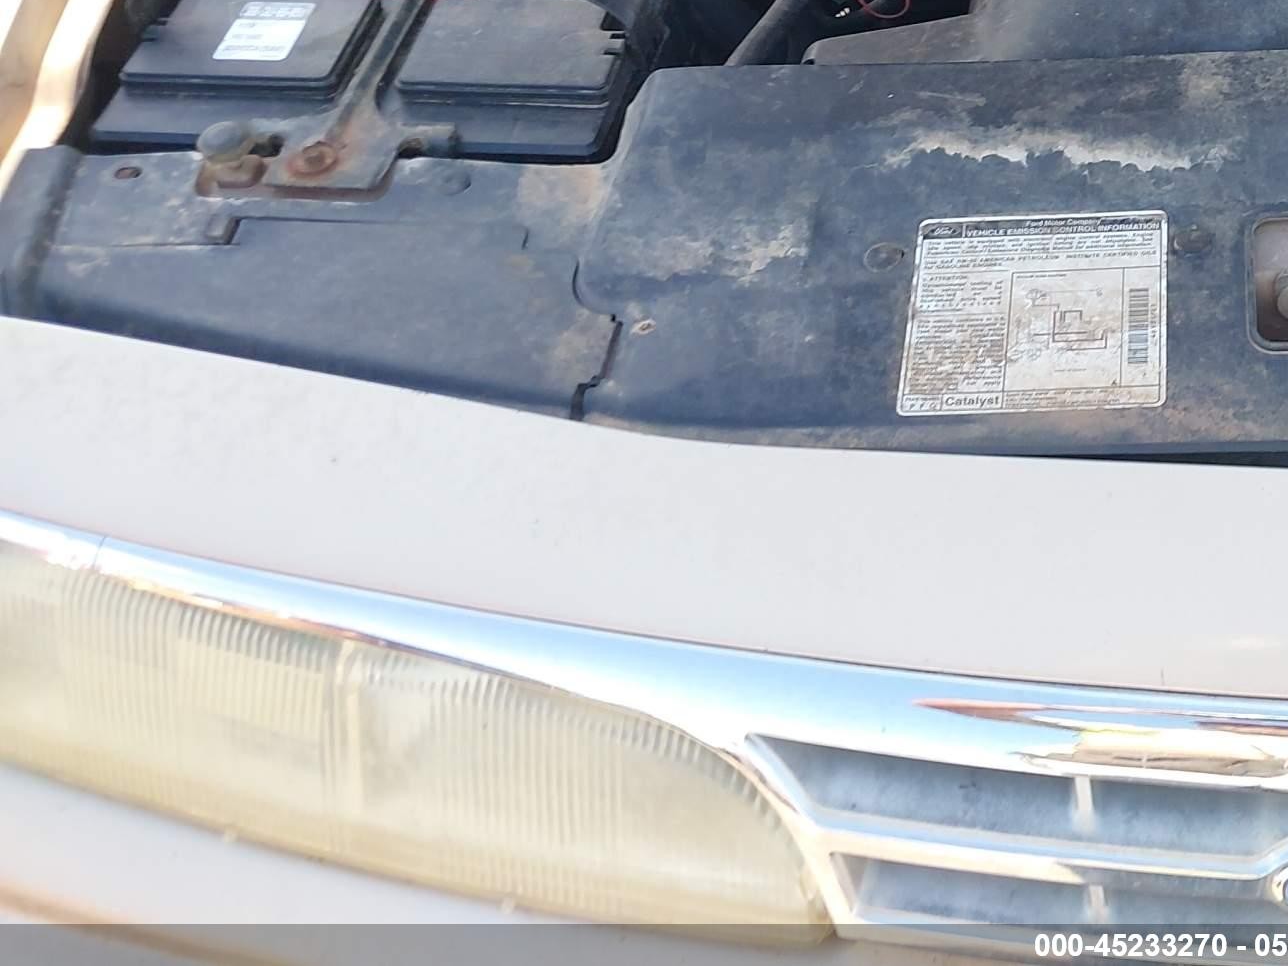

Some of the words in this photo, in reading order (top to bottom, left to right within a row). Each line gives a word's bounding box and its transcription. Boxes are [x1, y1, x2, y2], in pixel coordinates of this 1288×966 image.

[966, 228, 1005, 237] VEHICLE
[1005, 226, 1051, 236] EMISSION
[1054, 224, 1096, 234] CONTROL
[1097, 221, 1160, 232] INFORMATION
[944, 395, 999, 407] Catalyst
